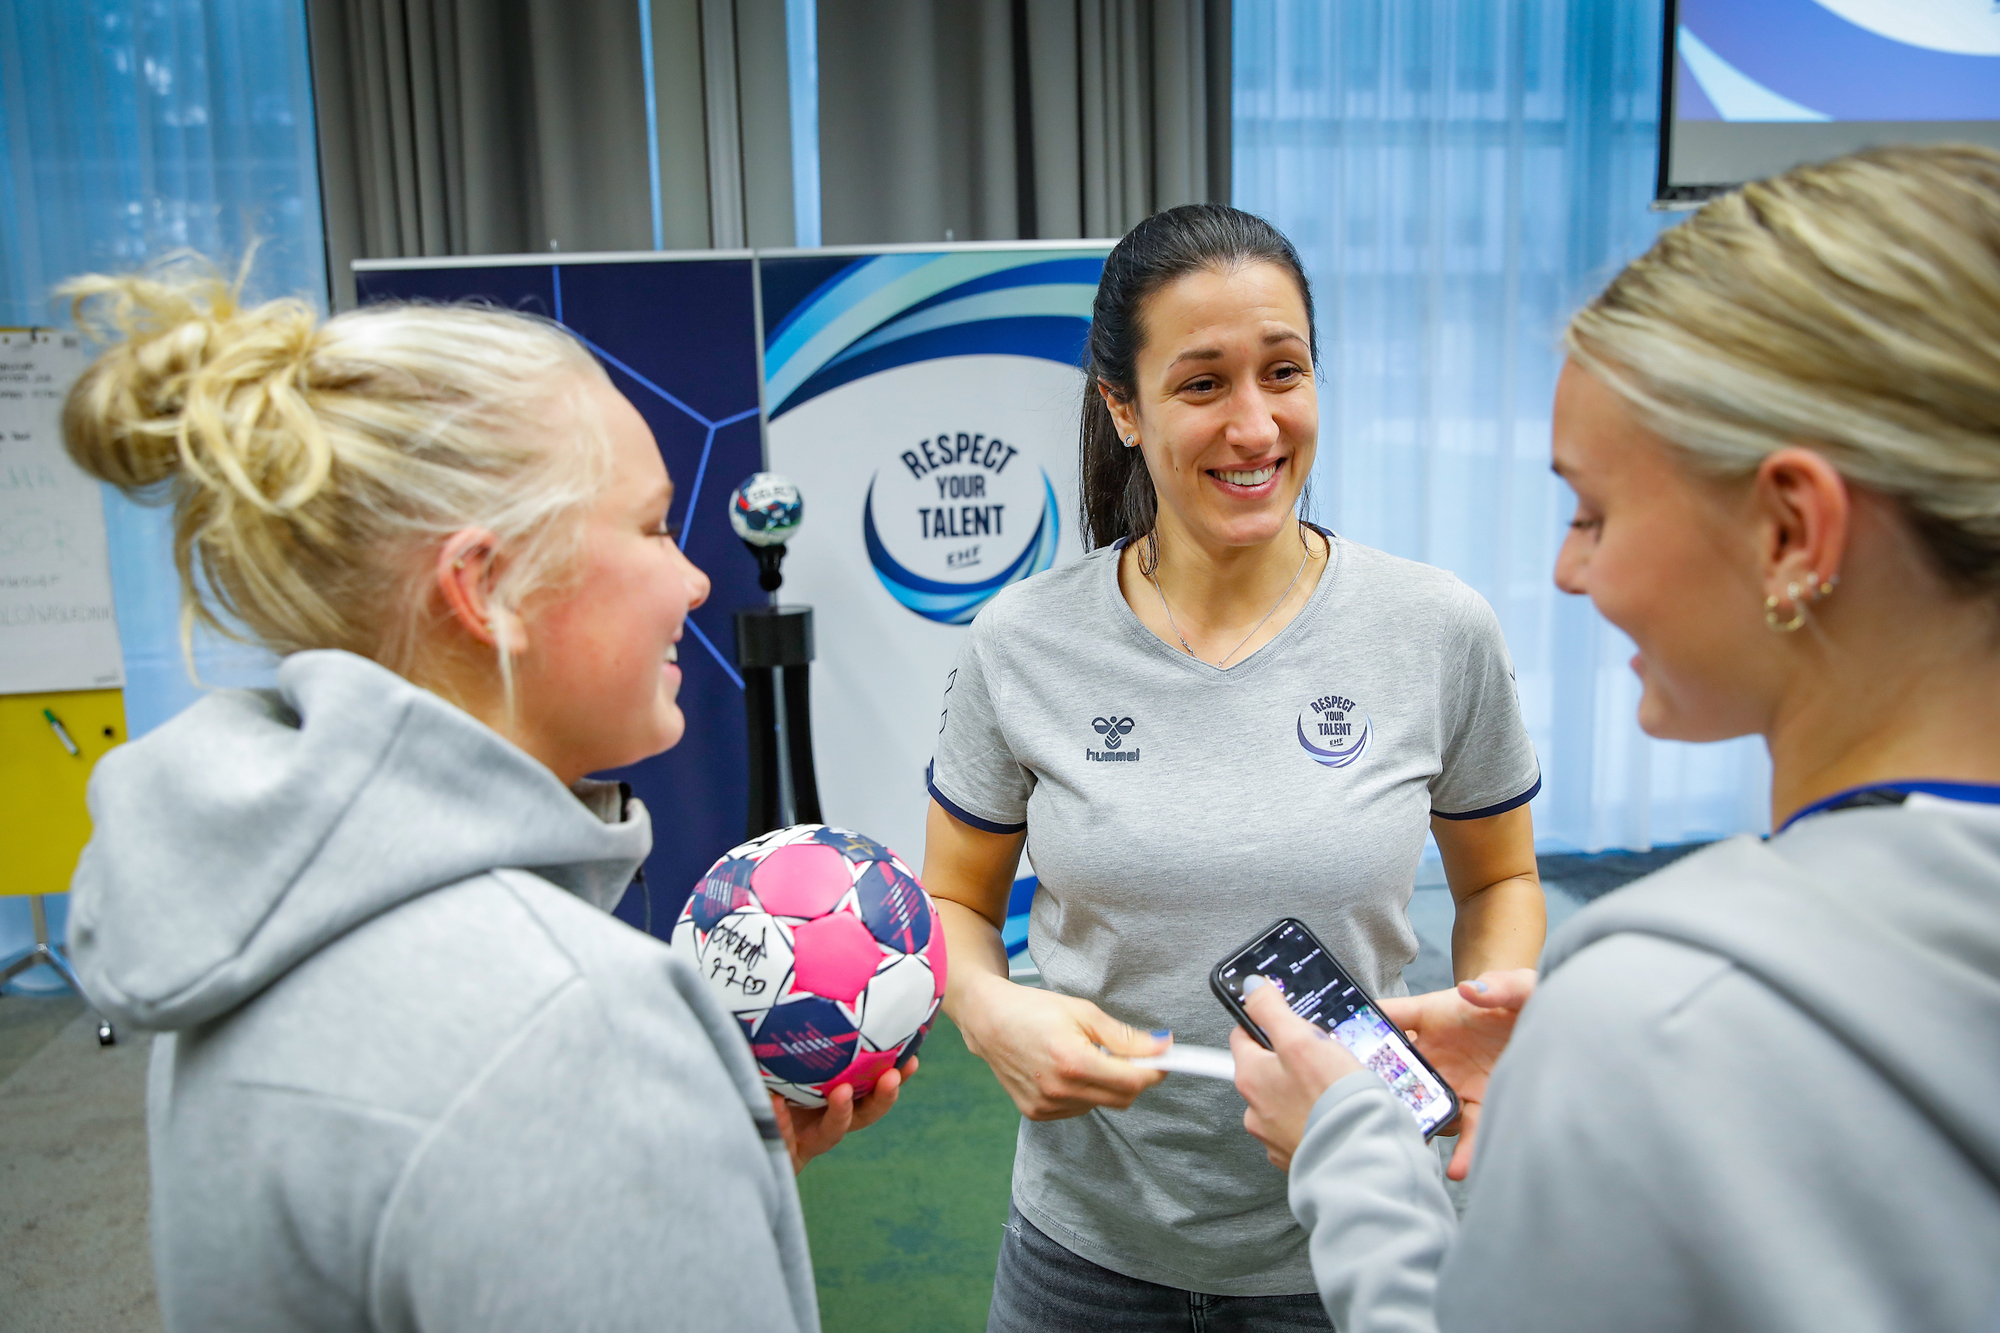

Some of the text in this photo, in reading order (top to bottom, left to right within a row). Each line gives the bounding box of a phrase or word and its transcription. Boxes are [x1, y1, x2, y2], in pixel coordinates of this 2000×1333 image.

[901, 433, 1018, 479] RESPECT
[936, 475, 986, 499] YOUR
[918, 505, 1004, 539] TALENT
[946, 545, 981, 566] EHF
[1310, 696, 1356, 714] RESPECT
[1324, 711, 1344, 721] YOUR
[1318, 723, 1351, 736] TALENT
[1330, 738, 1344, 746] EHF
[1086, 748, 1140, 762] hummel
